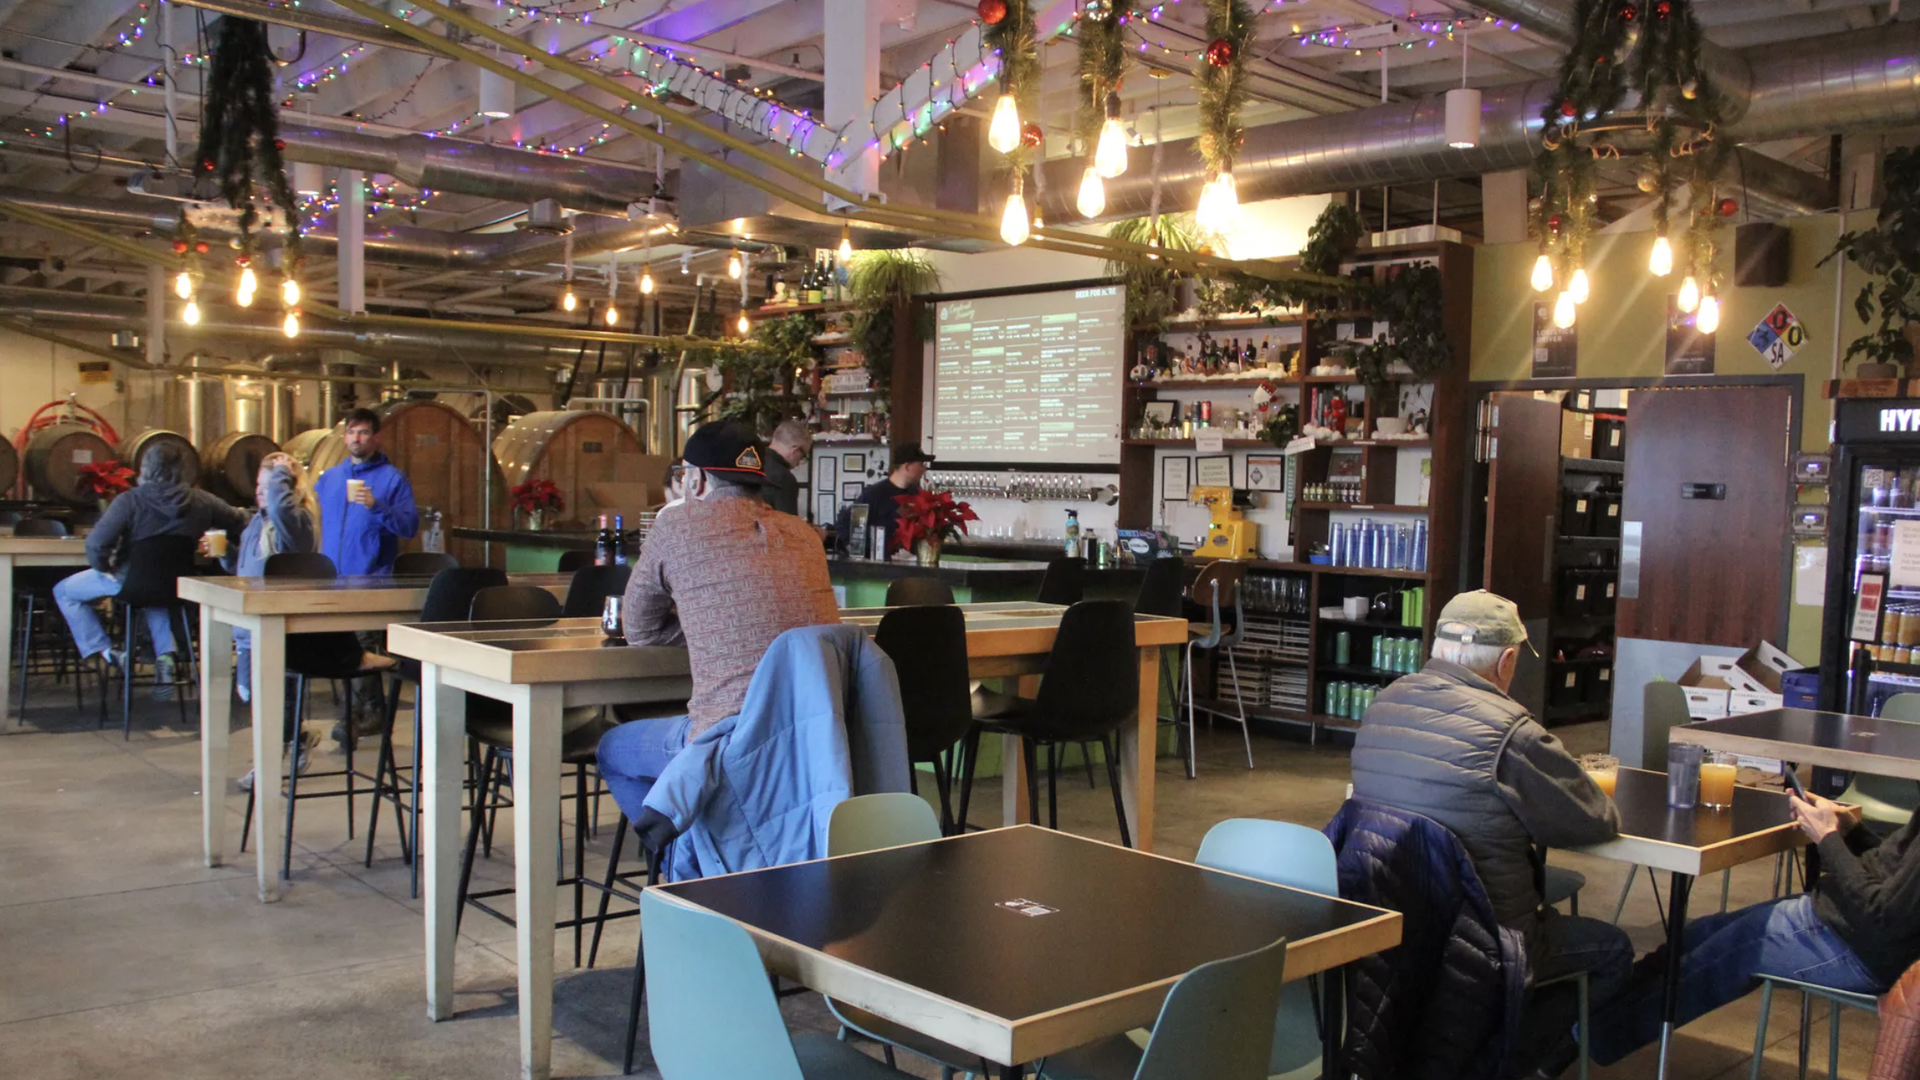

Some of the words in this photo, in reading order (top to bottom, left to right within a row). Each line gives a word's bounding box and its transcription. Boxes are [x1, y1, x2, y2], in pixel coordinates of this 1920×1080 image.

[1773, 310, 1787, 330] 0
[1788, 325, 1802, 346] 0
[1771, 342, 1784, 363] SA
